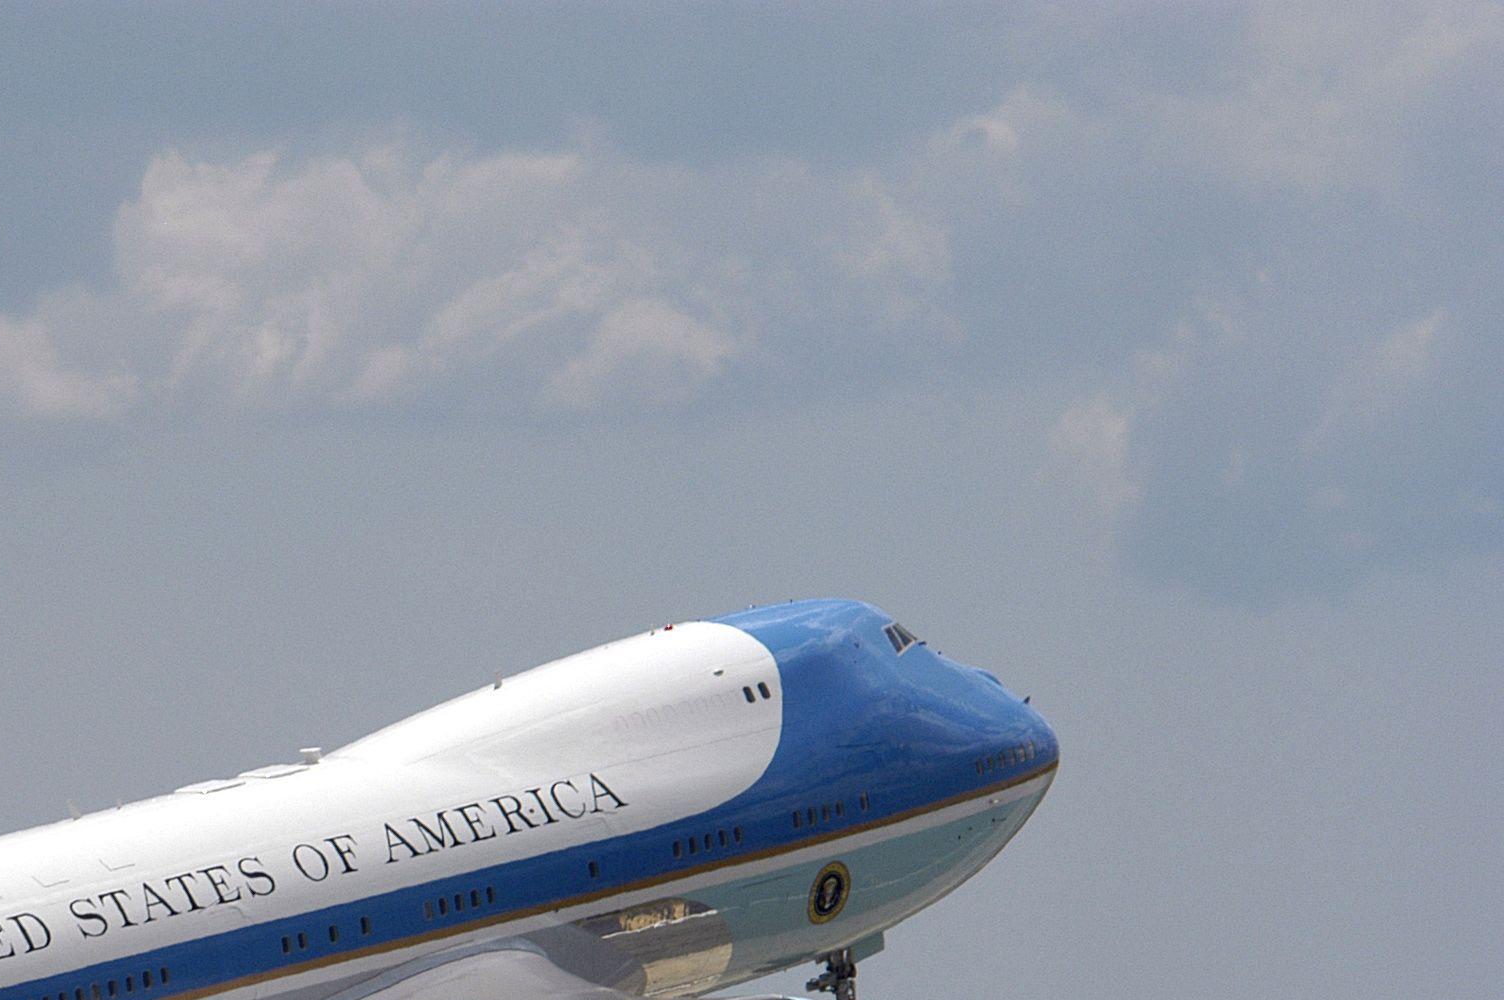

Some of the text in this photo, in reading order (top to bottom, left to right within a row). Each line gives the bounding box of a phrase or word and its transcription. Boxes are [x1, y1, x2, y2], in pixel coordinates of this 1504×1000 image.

[69, 857, 276, 939] STATES
[292, 834, 359, 882] OF
[384, 773, 629, 864] AMERICA
